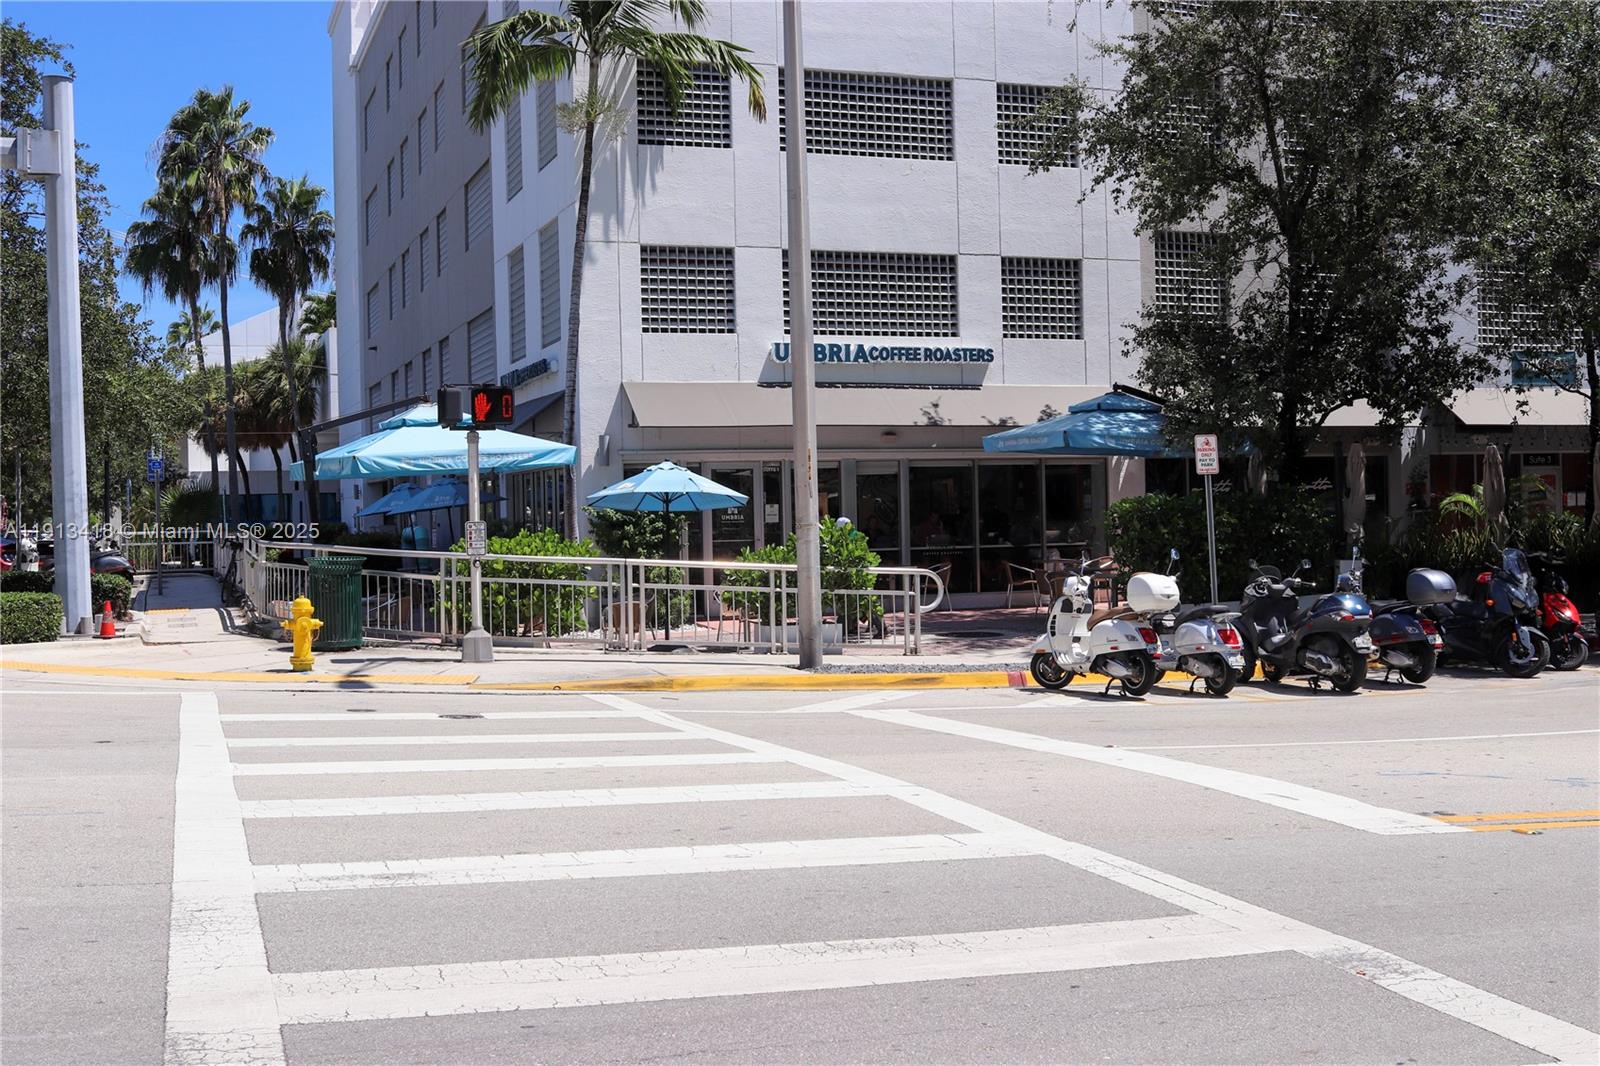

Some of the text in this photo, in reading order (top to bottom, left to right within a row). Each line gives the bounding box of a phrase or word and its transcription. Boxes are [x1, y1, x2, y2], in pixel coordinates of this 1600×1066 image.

[774, 342, 995, 363] UBRIA COFFEE ROASTERS
[502, 395, 512, 418] 0
